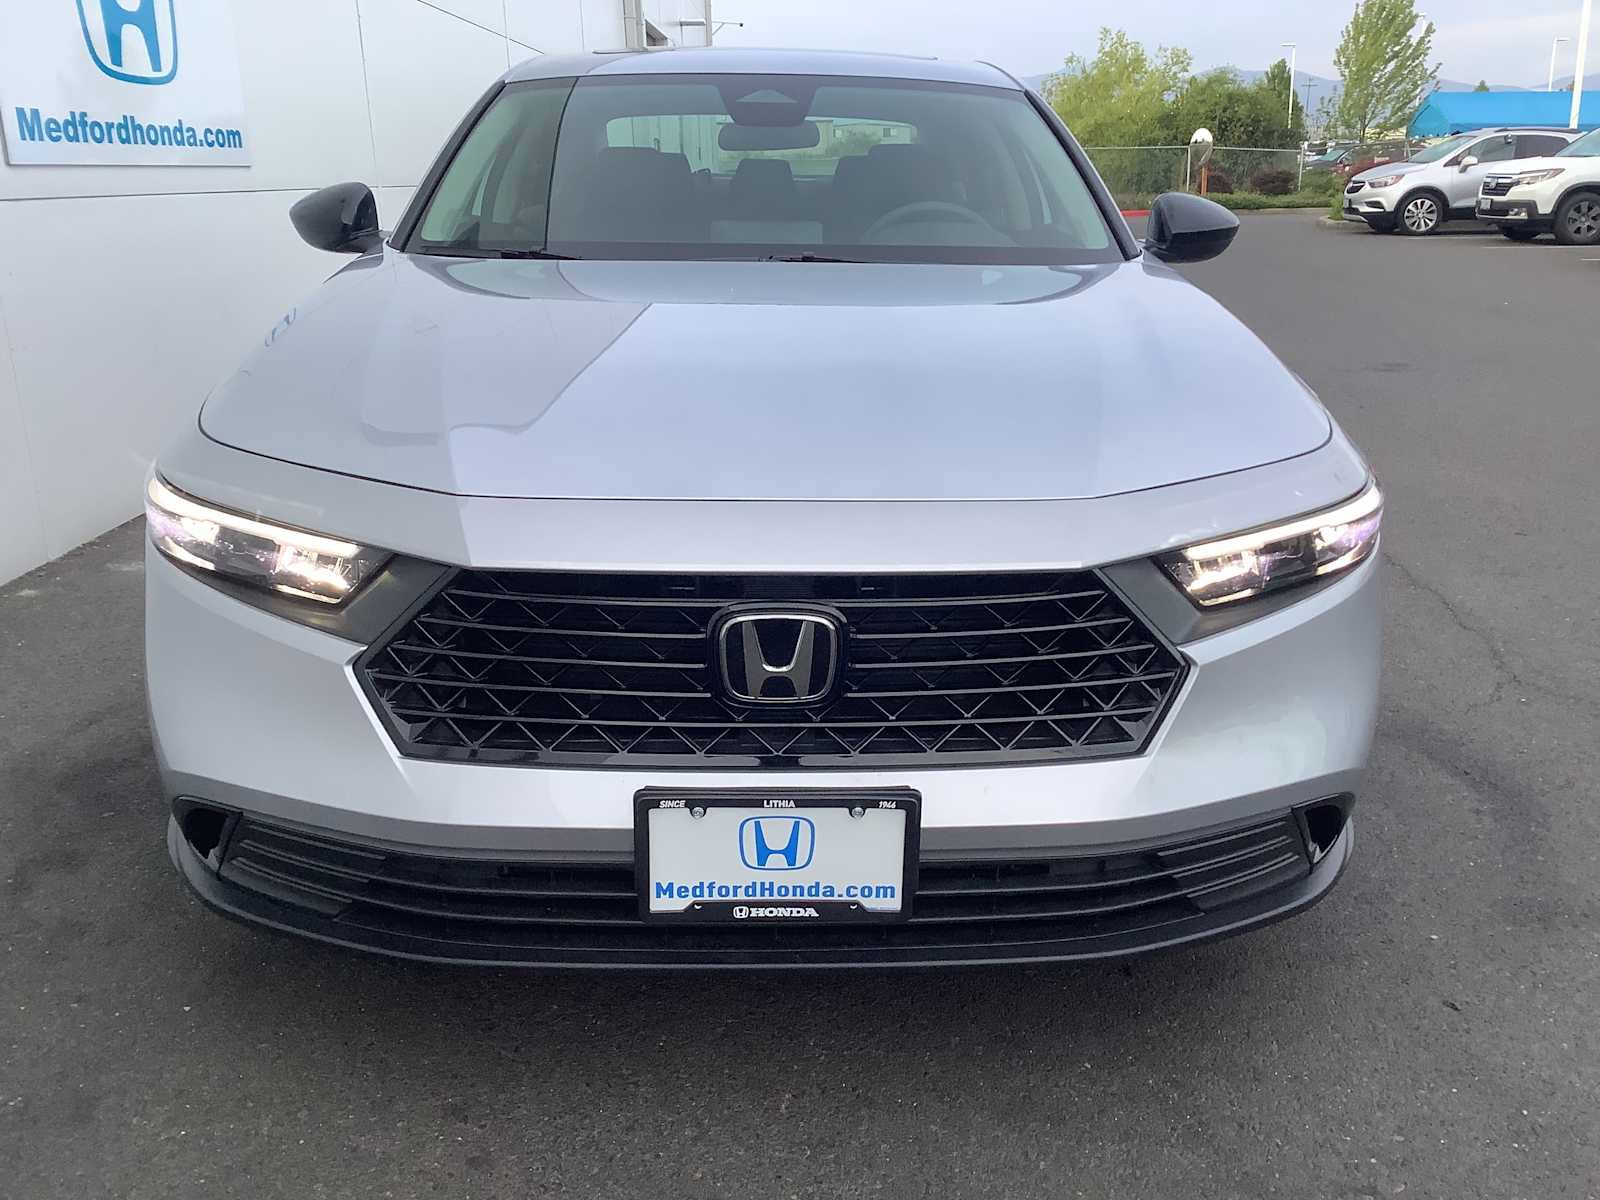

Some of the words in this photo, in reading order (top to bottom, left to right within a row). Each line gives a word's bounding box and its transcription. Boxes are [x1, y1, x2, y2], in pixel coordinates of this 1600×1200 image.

[15, 106, 243, 149] Medfordhonda.com
[659, 800, 686, 808] SINCE
[763, 800, 796, 808] LITHIA
[655, 881, 896, 898] MedfordHonda.com
[750, 907, 819, 918] HONDA
